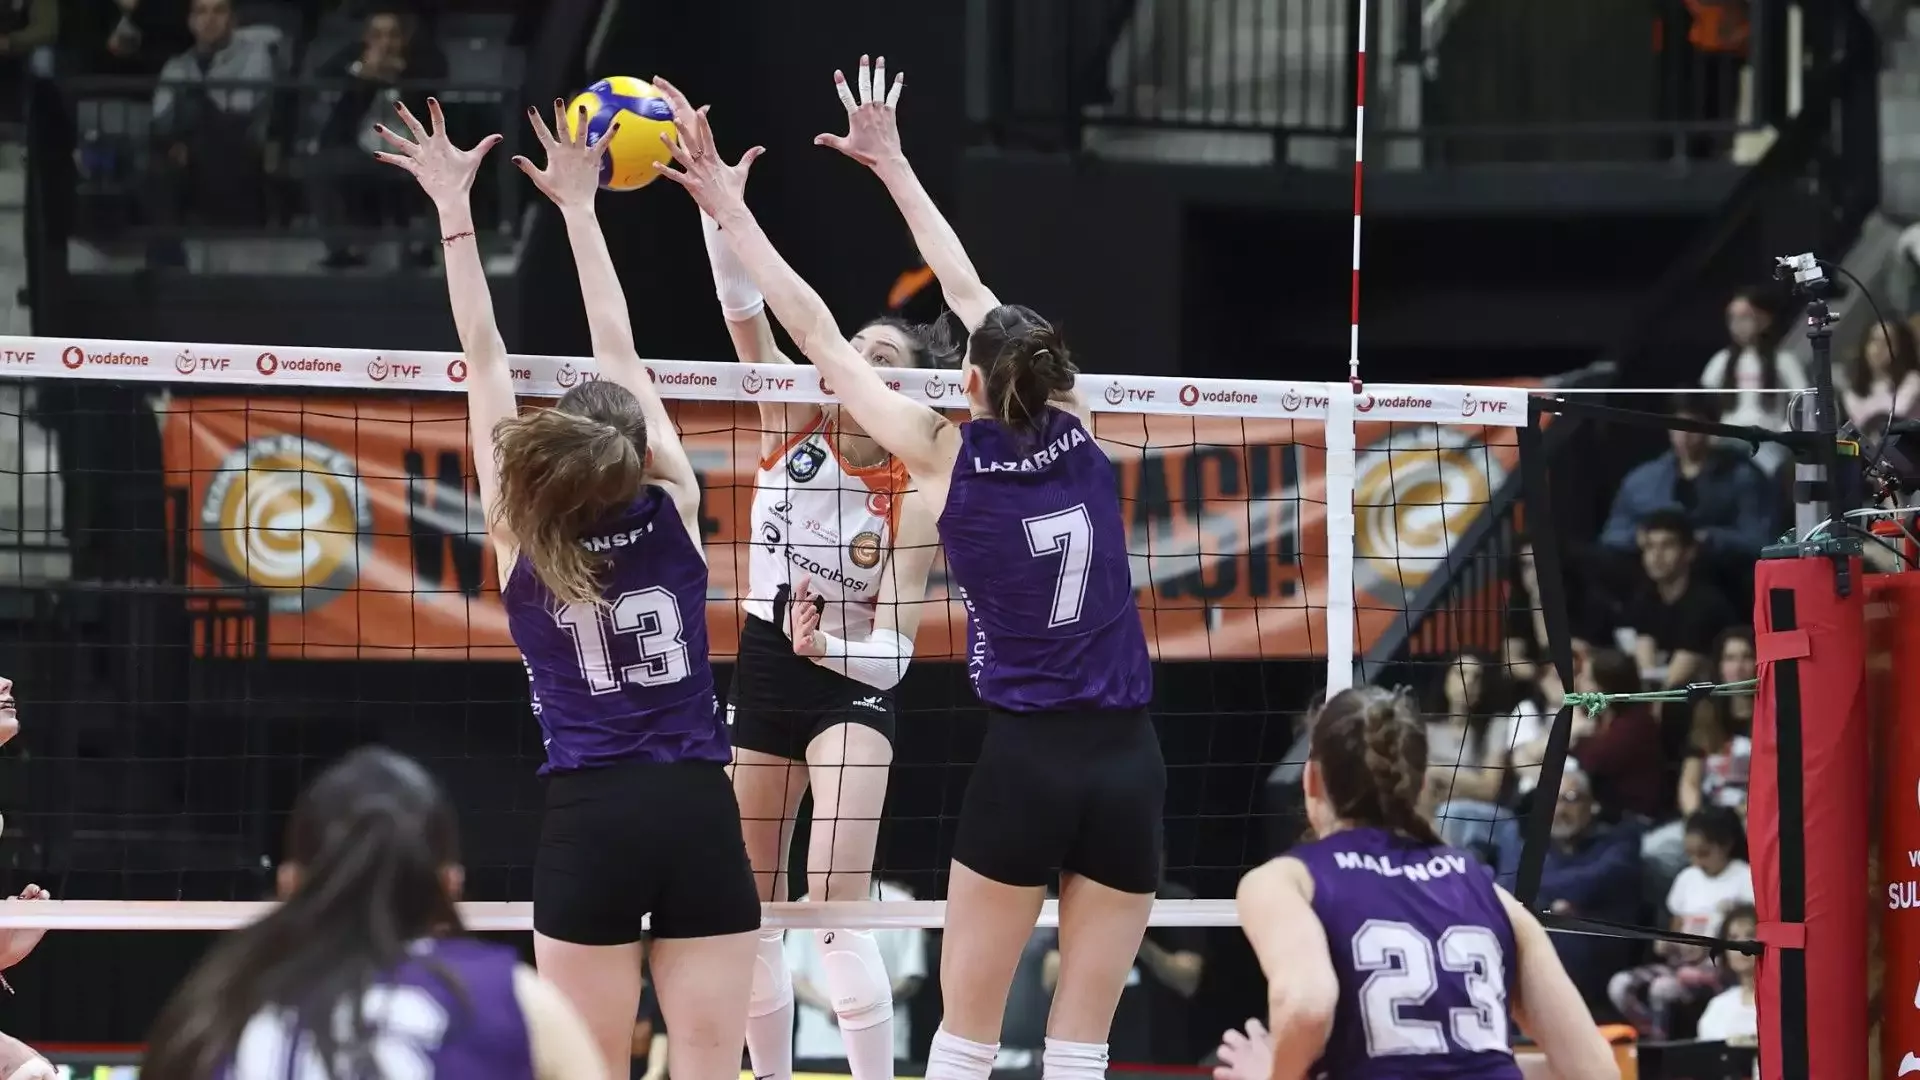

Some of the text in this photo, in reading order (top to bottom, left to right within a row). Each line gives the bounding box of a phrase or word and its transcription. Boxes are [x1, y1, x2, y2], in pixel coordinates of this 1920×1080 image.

[4, 351, 36, 364] TVF
[87, 353, 149, 366] vodafone
[200, 358, 231, 371] TVF
[281, 359, 342, 372] vodafone
[392, 365, 421, 378] TVF
[580, 372, 600, 382] TV
[658, 373, 718, 386] vodafone
[766, 378, 795, 390] TVF
[948, 384, 964, 395] TV
[1127, 389, 1156, 402] TVF
[1202, 391, 1258, 404] vodafone
[1377, 396, 1508, 413] vodafone TVF
[974, 427, 1087, 473] LAZAREVA
[1021, 502, 1094, 629] 7
[555, 585, 692, 695] 13
[1333, 851, 1466, 881] MALNOV
[1888, 881, 1920, 910] SUL
[1351, 919, 1513, 1059] 23
